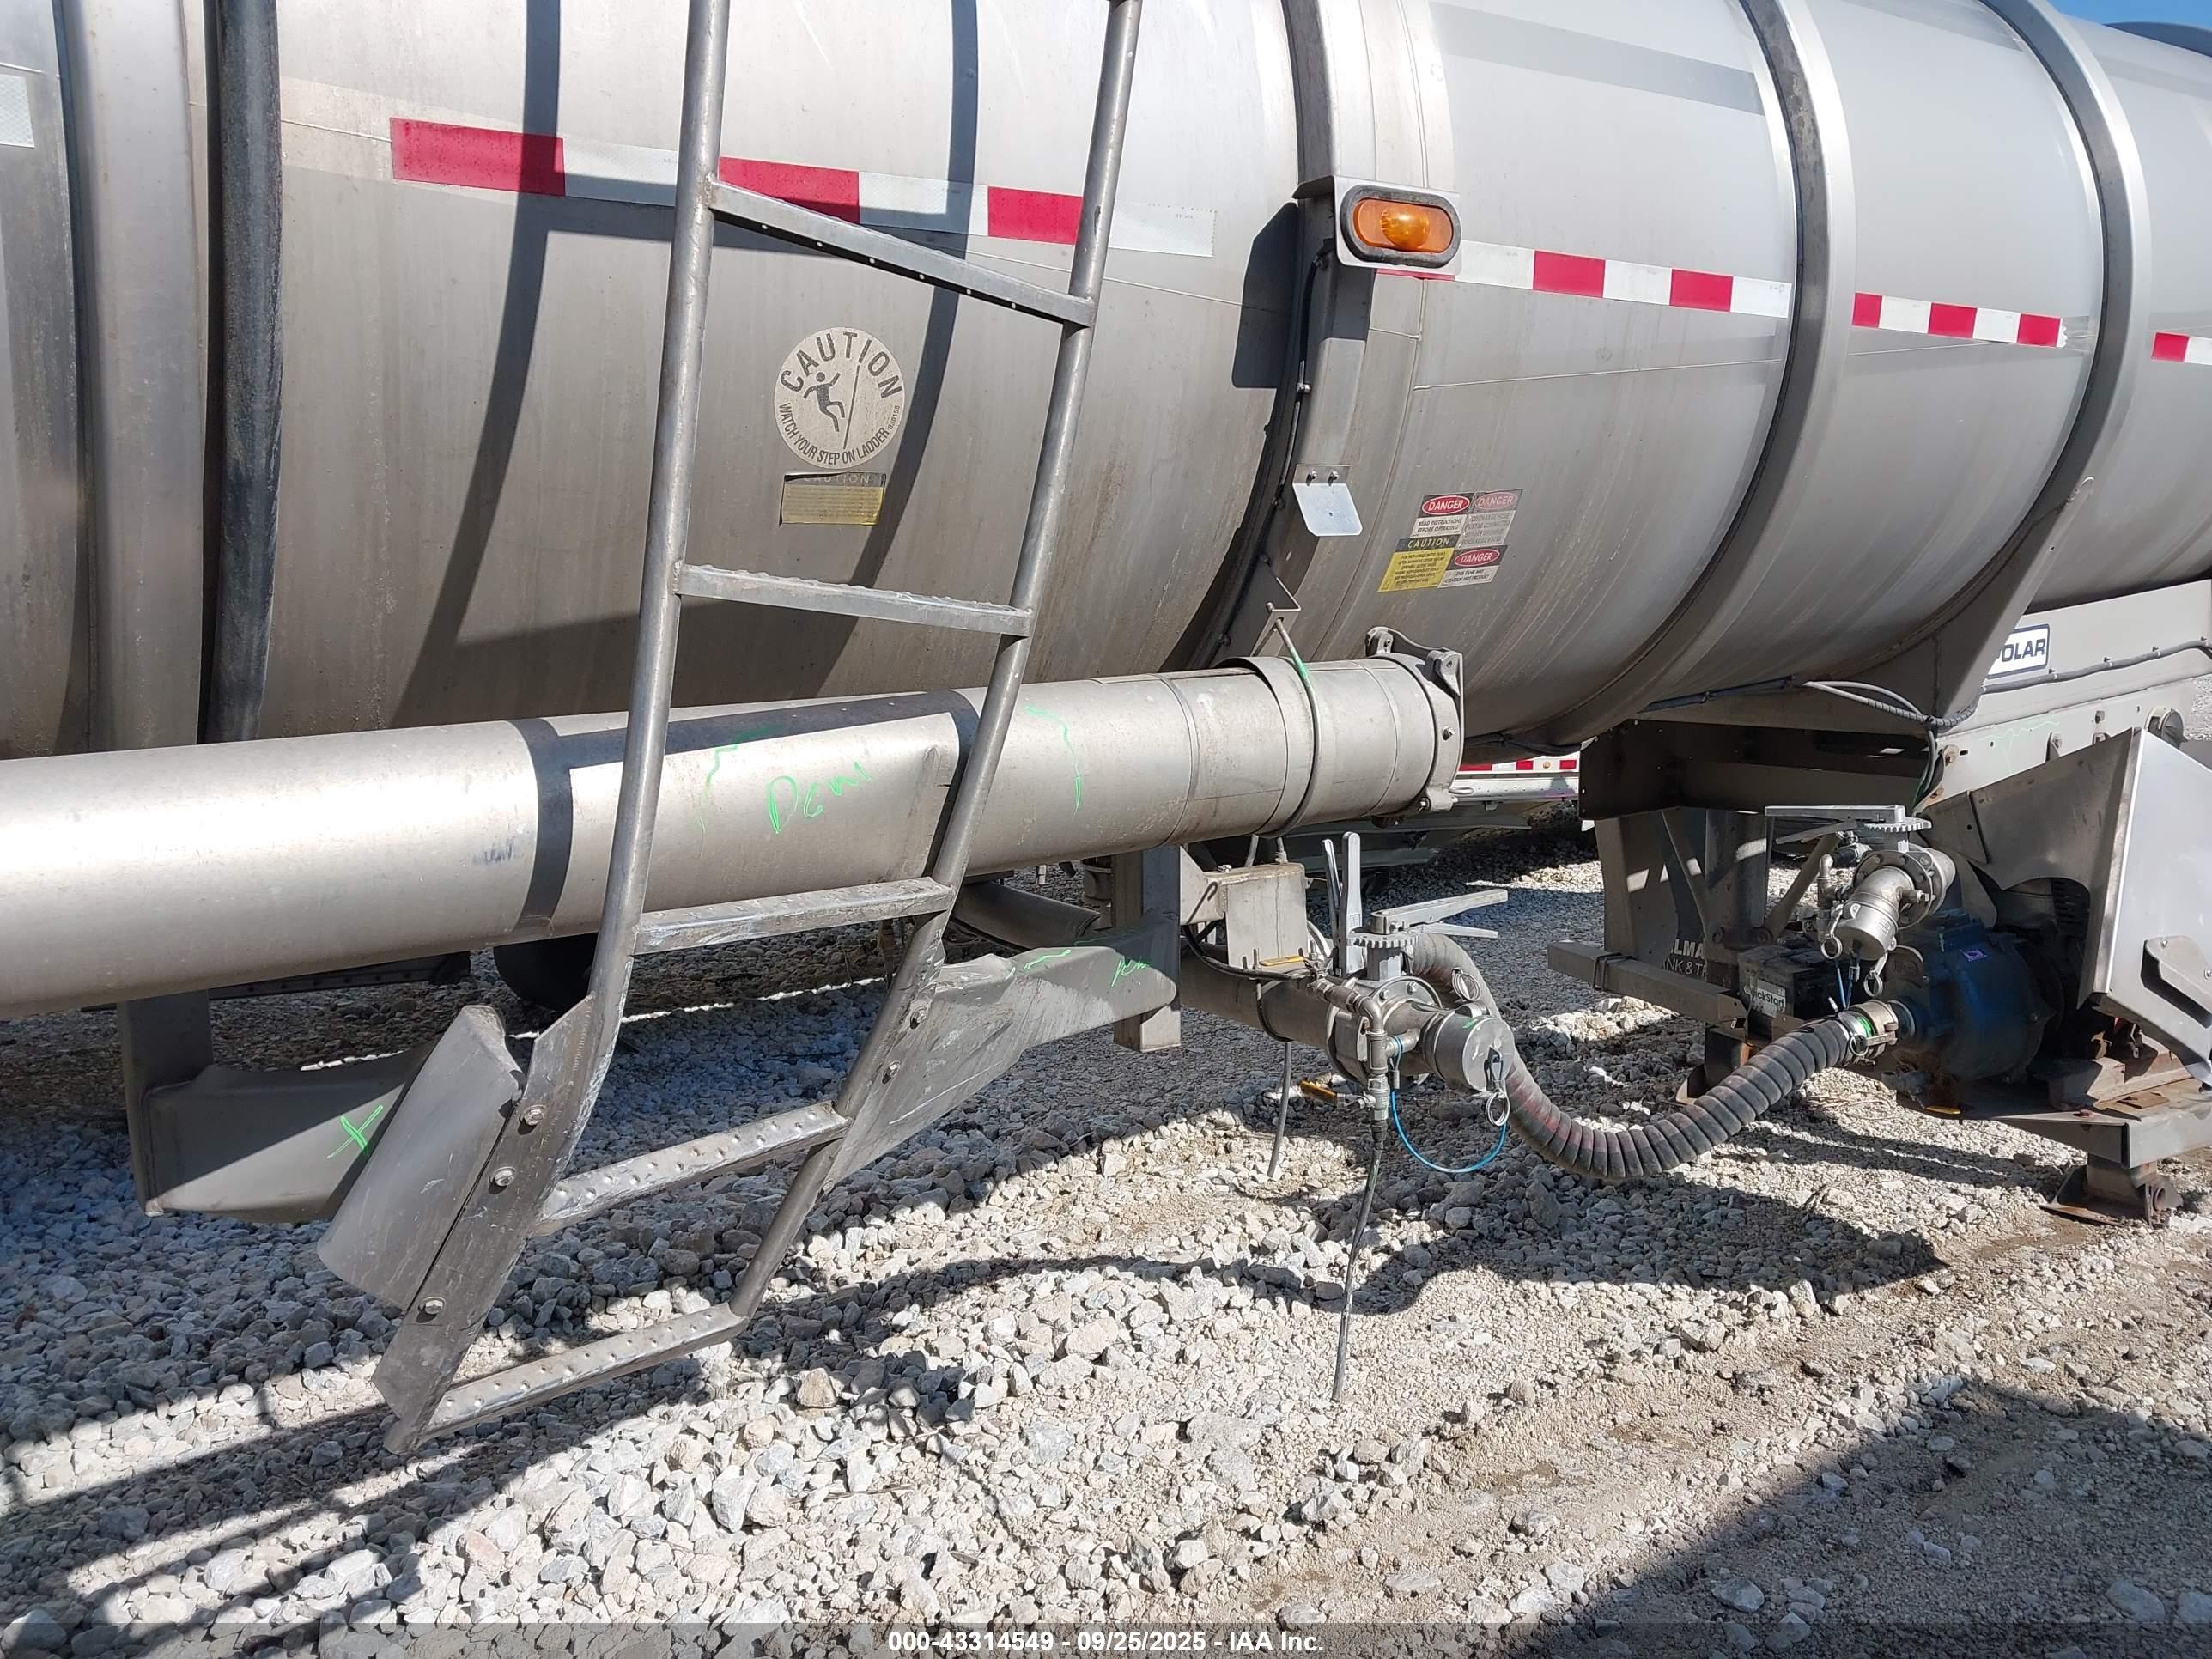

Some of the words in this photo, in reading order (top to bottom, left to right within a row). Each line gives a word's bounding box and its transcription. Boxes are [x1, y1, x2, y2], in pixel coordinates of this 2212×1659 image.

[780, 331, 902, 399] CAUTION
[779, 403, 798, 439] WATCH
[793, 430, 818, 457] YOUR
[817, 449, 840, 465] STEP
[842, 449, 856, 465] ON
[856, 427, 890, 460] LADDER
[1428, 499, 1464, 512] DANGER
[1478, 495, 1513, 507] DANGER
[1407, 538, 1450, 549] CAUTION
[1460, 552, 1493, 564] DANGER
[2002, 638, 2046, 663] OLAR
[1685, 961, 1694, 975] &
